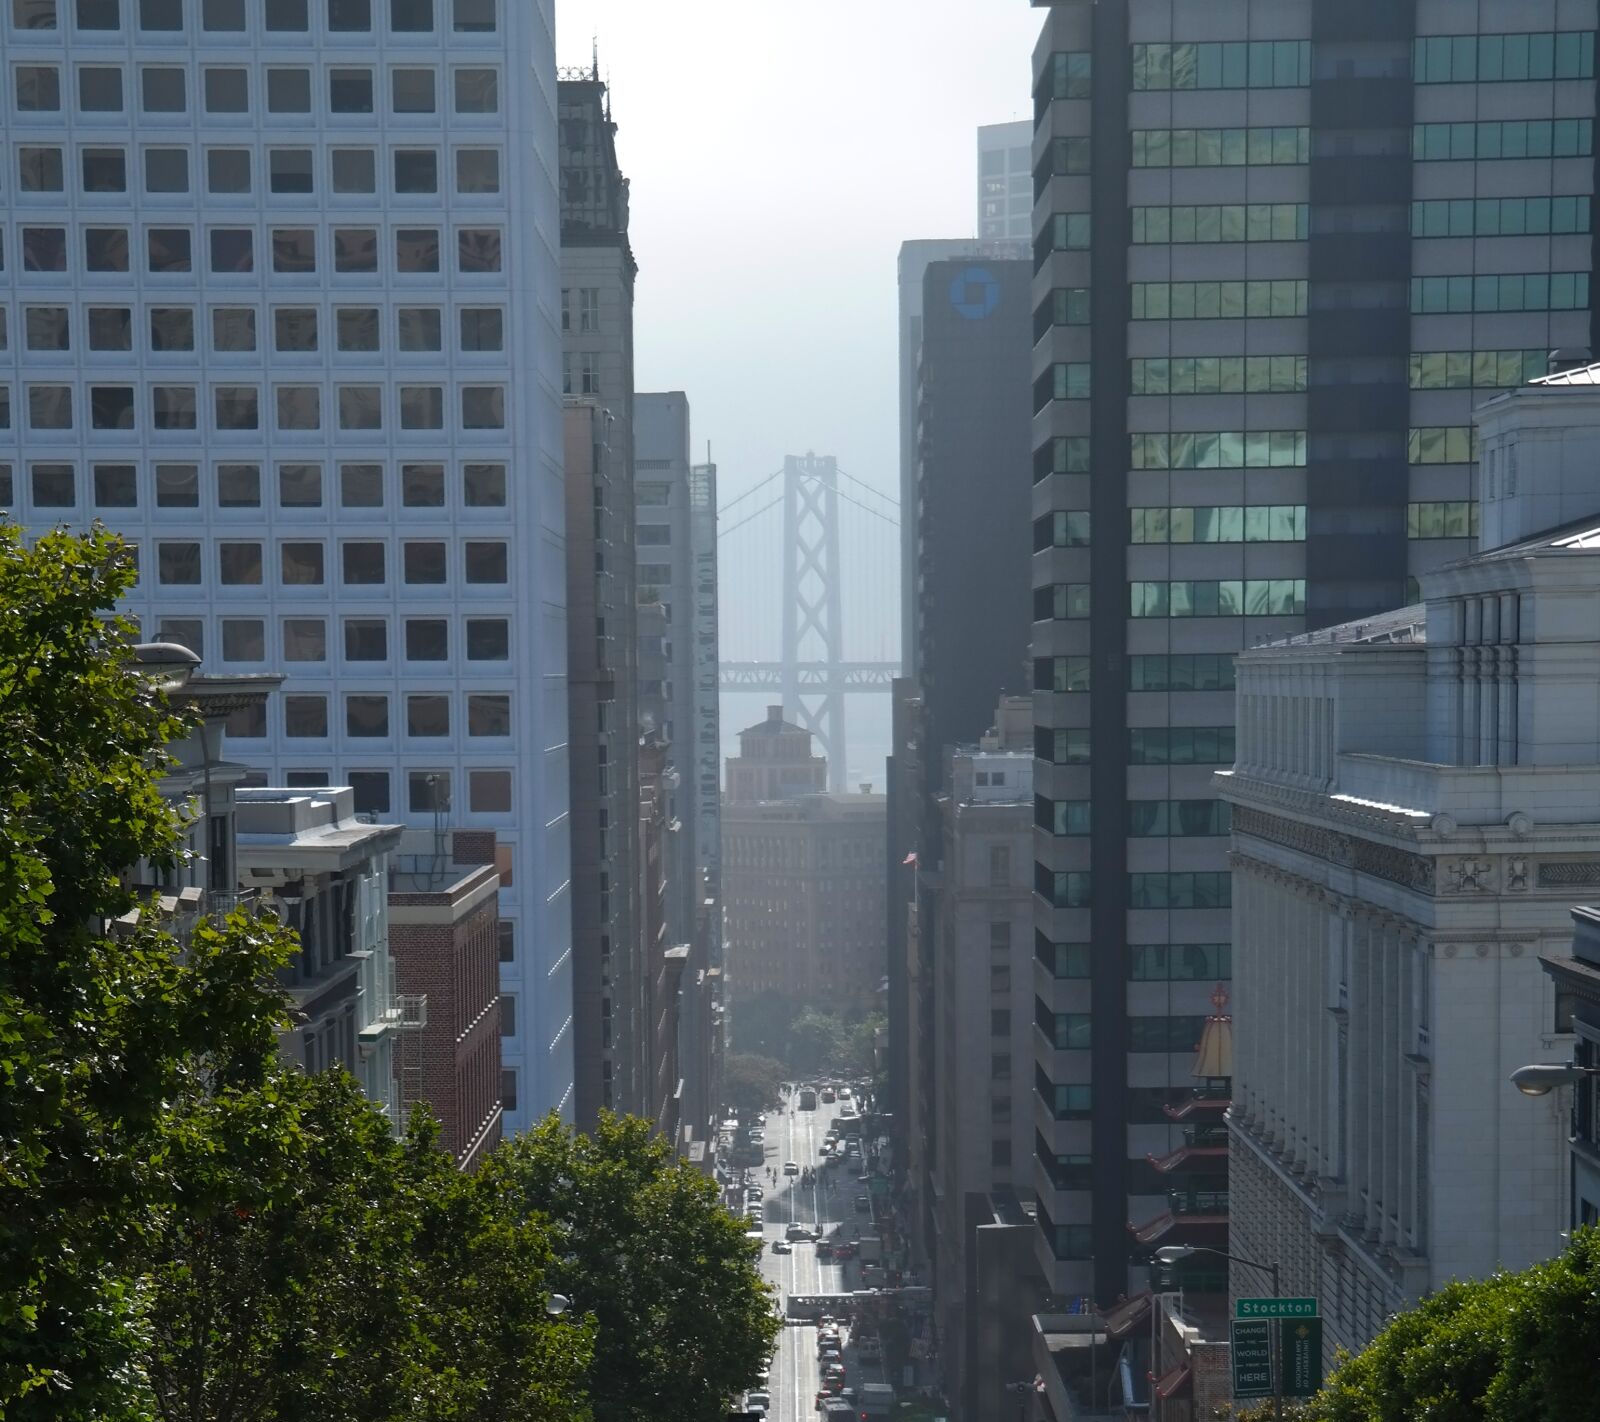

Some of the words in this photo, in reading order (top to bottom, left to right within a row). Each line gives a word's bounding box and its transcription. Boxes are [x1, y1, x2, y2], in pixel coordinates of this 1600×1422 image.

[1243, 1303, 1312, 1313] Stockton
[1235, 1327, 1267, 1335] CHANGE
[1239, 1373, 1267, 1382] HERE
